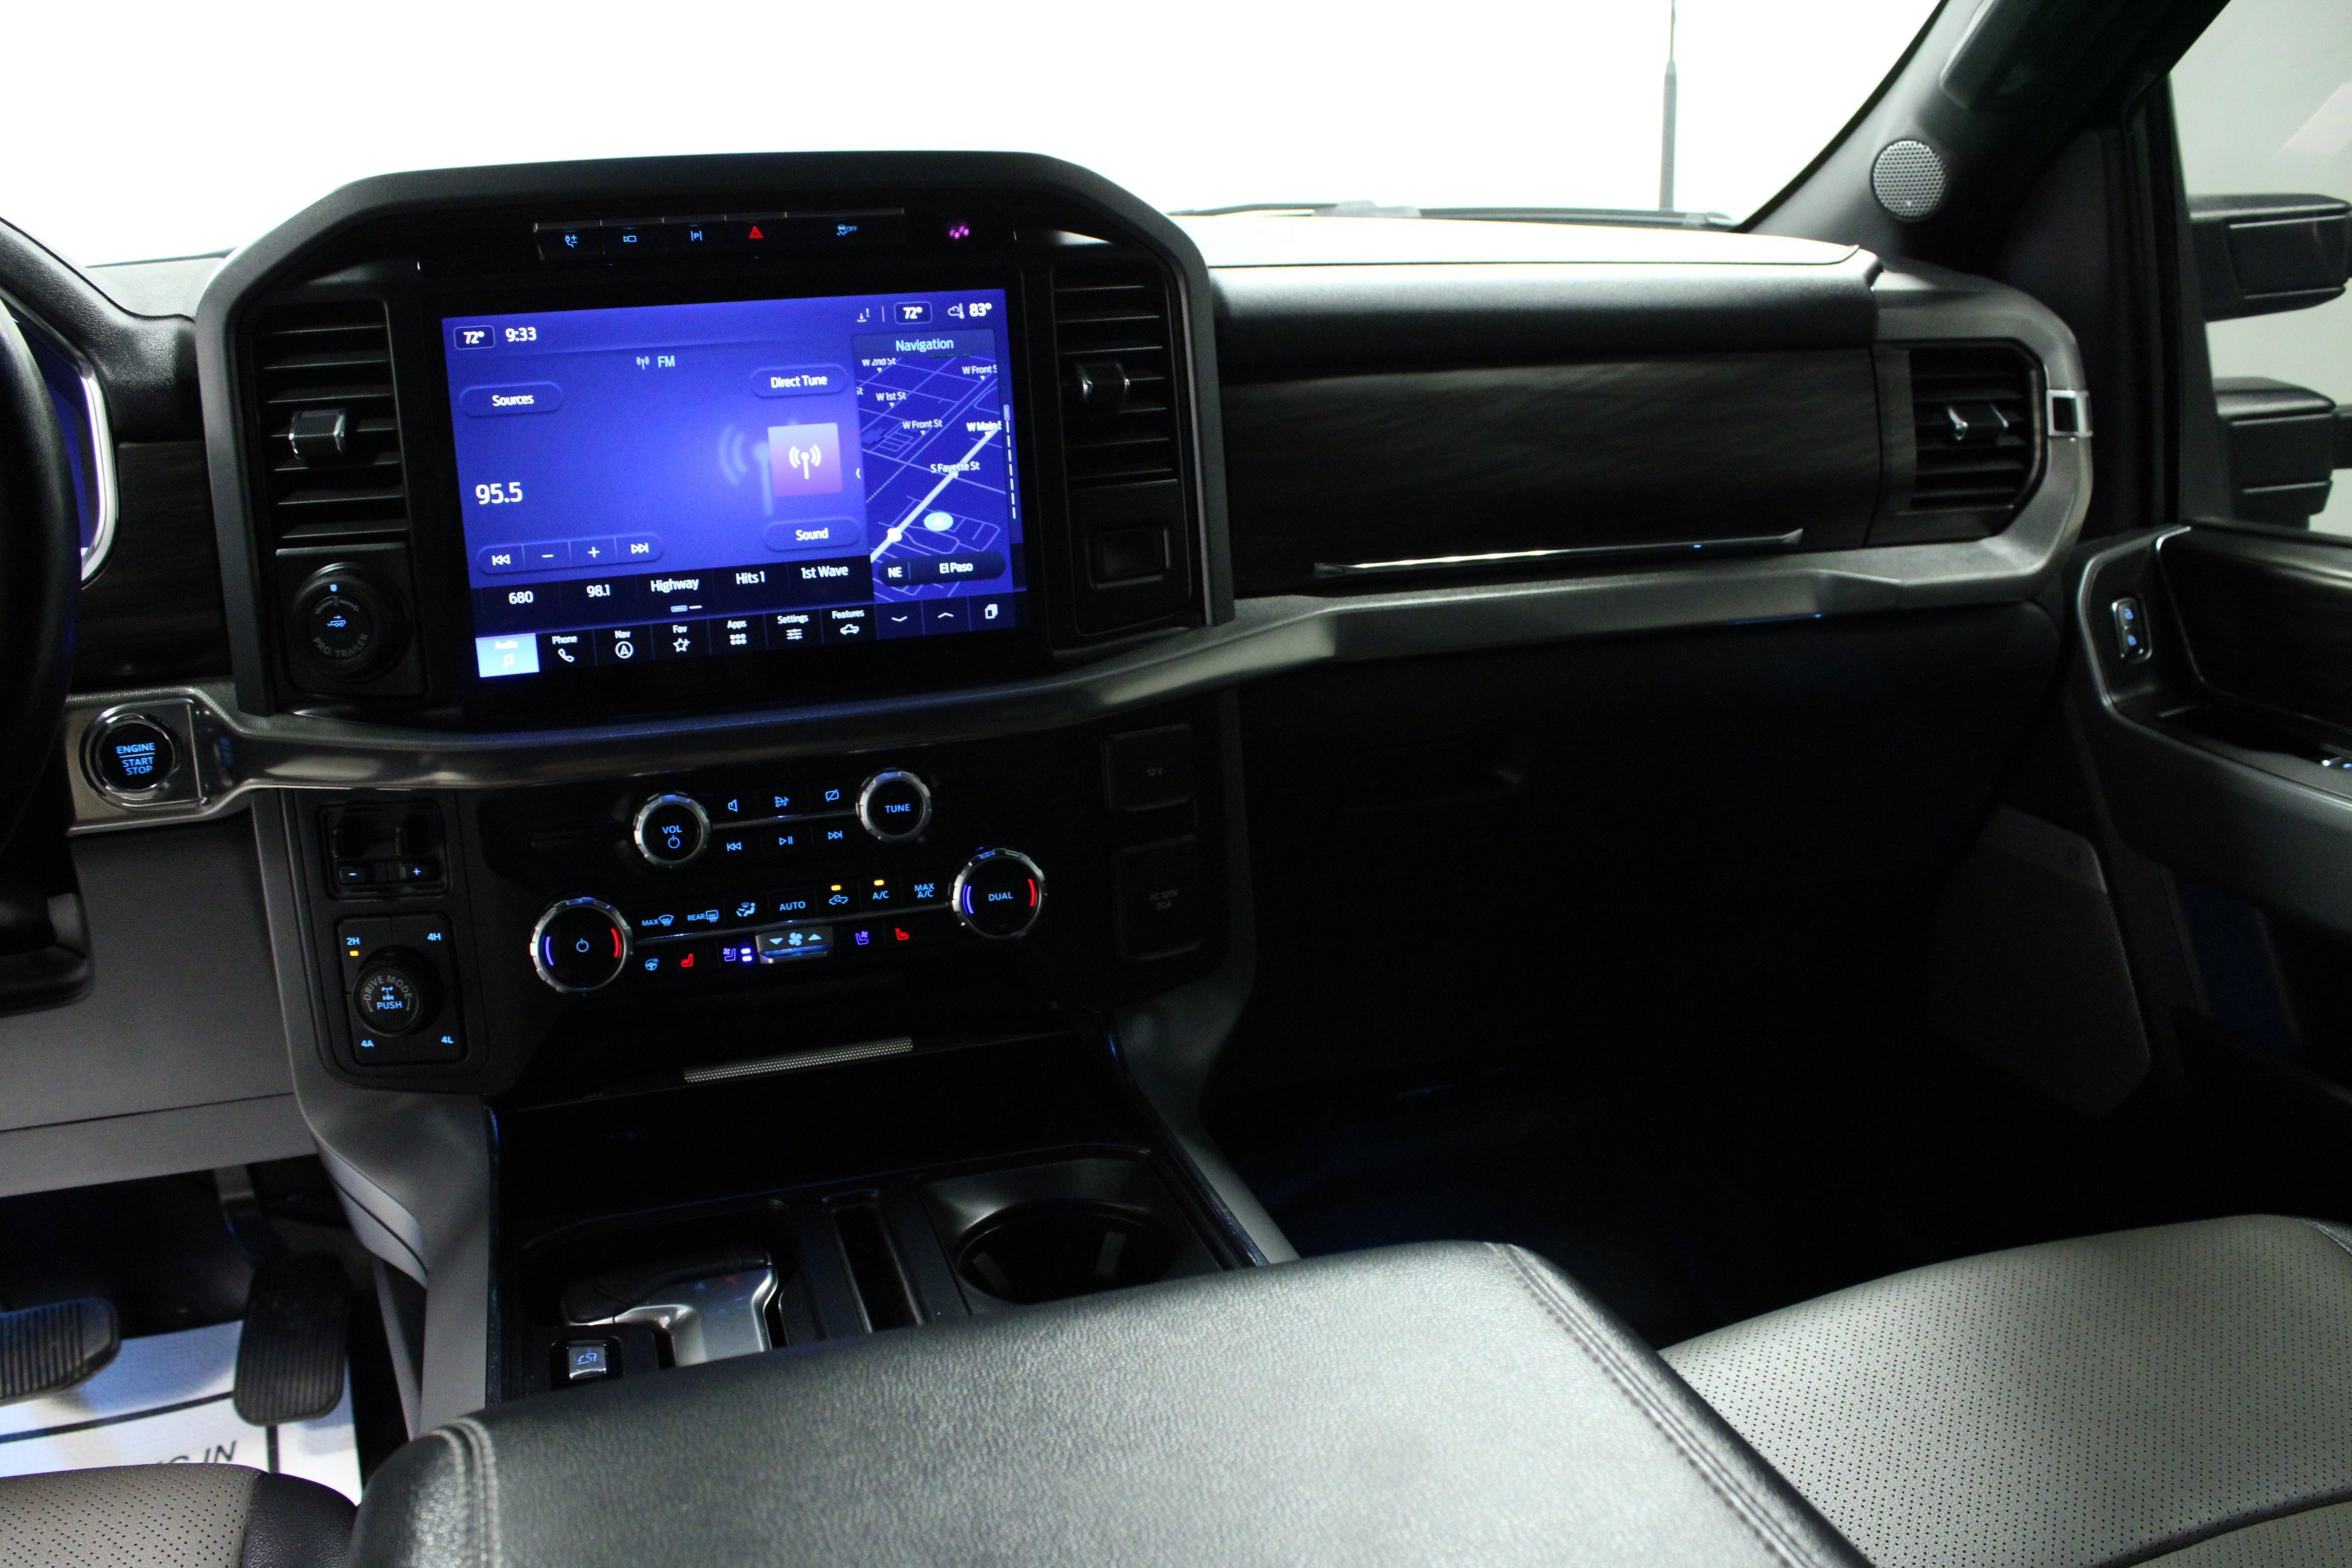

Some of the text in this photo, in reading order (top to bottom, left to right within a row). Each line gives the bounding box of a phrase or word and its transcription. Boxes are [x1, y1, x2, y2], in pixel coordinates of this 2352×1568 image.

[505, 326, 537, 342] 9:33
[895, 338, 954, 353] Navigation
[657, 355, 675, 368] FM
[887, 357, 897, 365] St
[962, 365, 971, 374] W
[971, 365, 992, 374] Front
[770, 374, 828, 388] Direct Tune
[492, 394, 534, 407] Sources
[876, 391, 907, 401] W 1st St
[902, 419, 943, 430] W Front St
[966, 422, 976, 432] W
[930, 460, 981, 473] S Fayette St
[475, 482, 523, 505] 95.5
[795, 527, 829, 541] Sound
[801, 565, 849, 579] 1st Wave
[887, 566, 903, 578] NE
[939, 562, 974, 574] El Paso
[735, 572, 759, 584] Hits
[650, 577, 700, 593] Highway
[586, 584, 610, 597] 98.1
[508, 591, 534, 605] 680
[777, 613, 809, 625] Settings
[831, 609, 864, 620] Features
[672, 624, 688, 634] Fav
[727, 619, 747, 630] Apps
[614, 629, 631, 639] Nav
[552, 635, 578, 645] Phone
[313, 633, 369, 658] PRO TRAILER
[116, 742, 156, 754] ENGINE
[122, 757, 154, 767] START
[126, 766, 153, 776] STOP
[885, 803, 911, 813] TUNE
[662, 825, 682, 834] VOL
[914, 883, 935, 891] MAX
[872, 890, 890, 900] A/C
[917, 890, 935, 899] A/C
[988, 891, 1014, 901] DUAL
[779, 901, 806, 911] AUTO
[687, 913, 706, 922] REAR
[642, 919, 659, 927] MAX
[347, 937, 360, 945] 2H
[427, 933, 442, 941] 4H
[363, 975, 412, 1001] DRIVE MODE
[377, 1001, 403, 1010] PUSH
[441, 1035, 454, 1044] 4L
